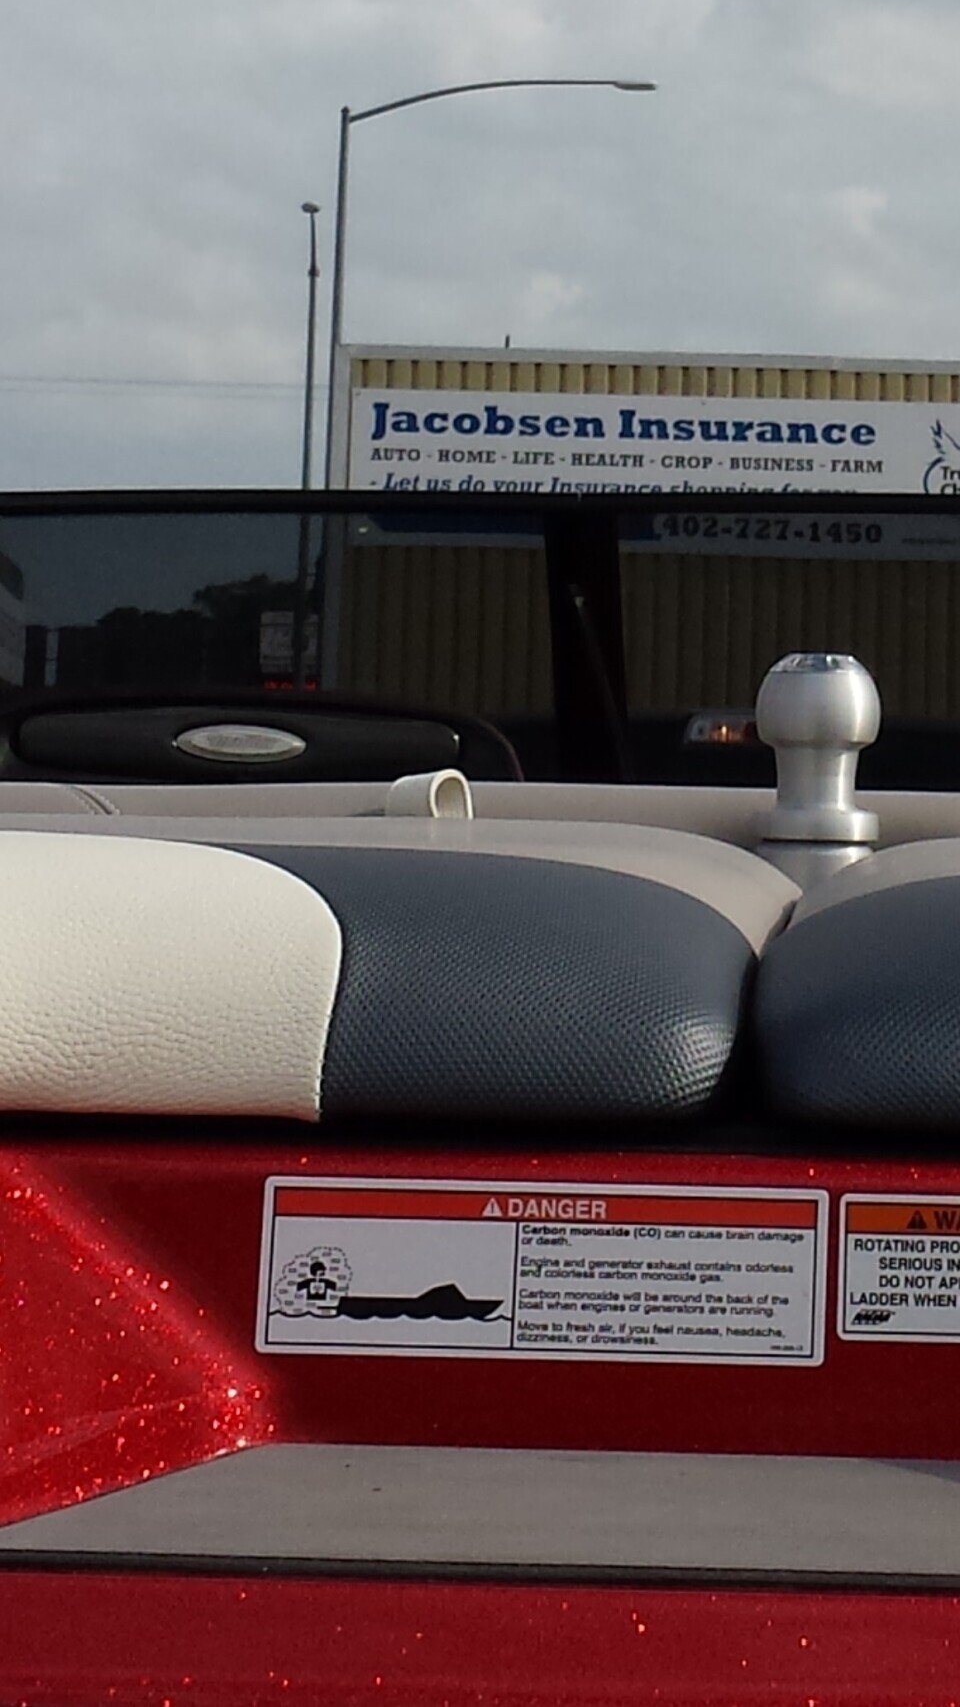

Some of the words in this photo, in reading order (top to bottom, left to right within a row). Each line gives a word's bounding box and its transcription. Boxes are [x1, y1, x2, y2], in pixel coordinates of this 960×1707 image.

[371, 403, 605, 440] Jacobsen
[619, 410, 876, 445] Insurance
[370, 448, 421, 462] AUTO
[437, 449, 496, 464] HOME
[512, 451, 555, 465] LIFE
[571, 453, 644, 468] HEALTH
[661, 455, 713, 469] CROP
[730, 457, 814, 472] BUSINESS
[830, 459, 883, 474] FARM
[382, 472, 420, 491] Let
[427, 478, 452, 491] us
[458, 474, 486, 492] do
[493, 480, 544, 493] your
[550, 476, 663, 493] Insurance
[662, 515, 883, 544] 402-727-1450
[508, 1198, 607, 1220] DANGER
[521, 1237, 534, 1245] or
[522, 1224, 566, 1235] Carbon
[570, 1226, 631, 1237] monoxide
[633, 1227, 662, 1240] (CO)
[664, 1230, 685, 1238] can
[688, 1230, 723, 1239] cause
[726, 1230, 754, 1240] brain
[758, 1231, 804, 1243] damage
[854, 1238, 926, 1253] ROTATING
[521, 1256, 560, 1268] Engine
[563, 1258, 586, 1268] and
[588, 1259, 644, 1270] generator
[646, 1260, 691, 1271] exhaust
[694, 1261, 742, 1272] contains
[879, 1256, 943, 1271] SERIOUS
[520, 1268, 541, 1278] and
[598, 1270, 638, 1280] carbon
[879, 1275, 900, 1288] DO
[904, 1276, 935, 1289] NOT
[519, 1288, 560, 1299] Carbon
[644, 1292, 659, 1302] be
[662, 1293, 702, 1303] around
[705, 1293, 723, 1304] the
[726, 1294, 754, 1304] back
[771, 1295, 789, 1305] the
[849, 1292, 909, 1306] LADDER
[913, 1294, 957, 1308] WHEN
[580, 1302, 626, 1314] engines
[628, 1325, 650, 1335] you
